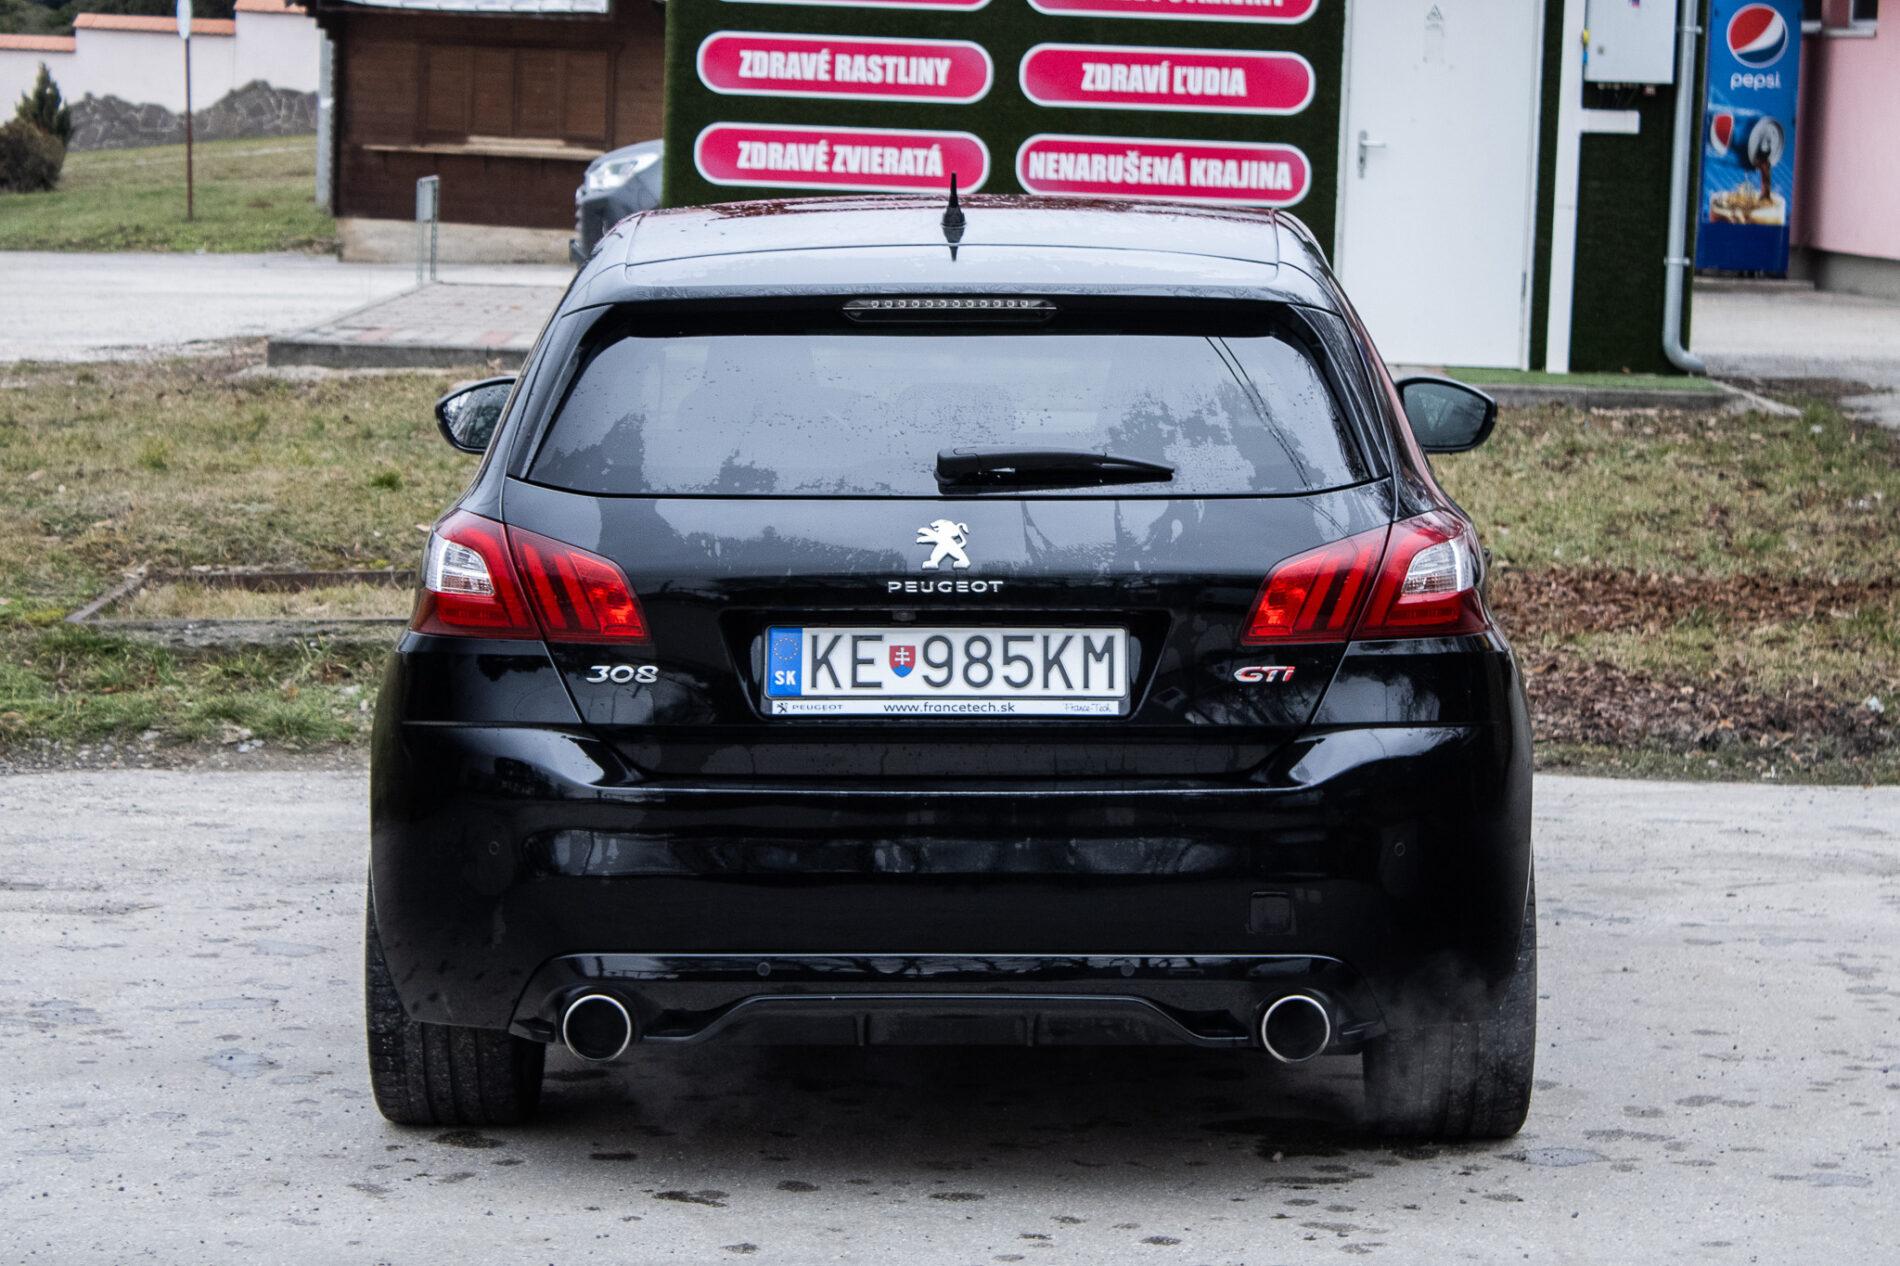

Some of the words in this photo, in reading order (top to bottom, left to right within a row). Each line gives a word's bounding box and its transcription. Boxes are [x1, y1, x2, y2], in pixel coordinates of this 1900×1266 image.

[738, 48, 832, 81] ZDRAVÉ
[834, 55, 952, 87] RASTLINY
[1081, 62, 1170, 94] ZDRAVÍ
[1173, 62, 1248, 97] ĽUDIA
[1730, 71, 1782, 90] pepsi
[736, 139, 831, 172] ZDRAVÉ
[832, 139, 944, 178] ZVIERATÁ
[1028, 145, 1186, 186] NENARUŠENÁ
[1189, 155, 1293, 191] KRAJINA
[887, 580, 1004, 593] PEUGEOT
[810, 634, 884, 689] KE
[921, 634, 1115, 690] 985KM
[586, 665, 659, 683] 308
[774, 670, 797, 686] SK
[792, 703, 843, 711] PEUGEOT
[883, 701, 1015, 713] www.francetech.sk
